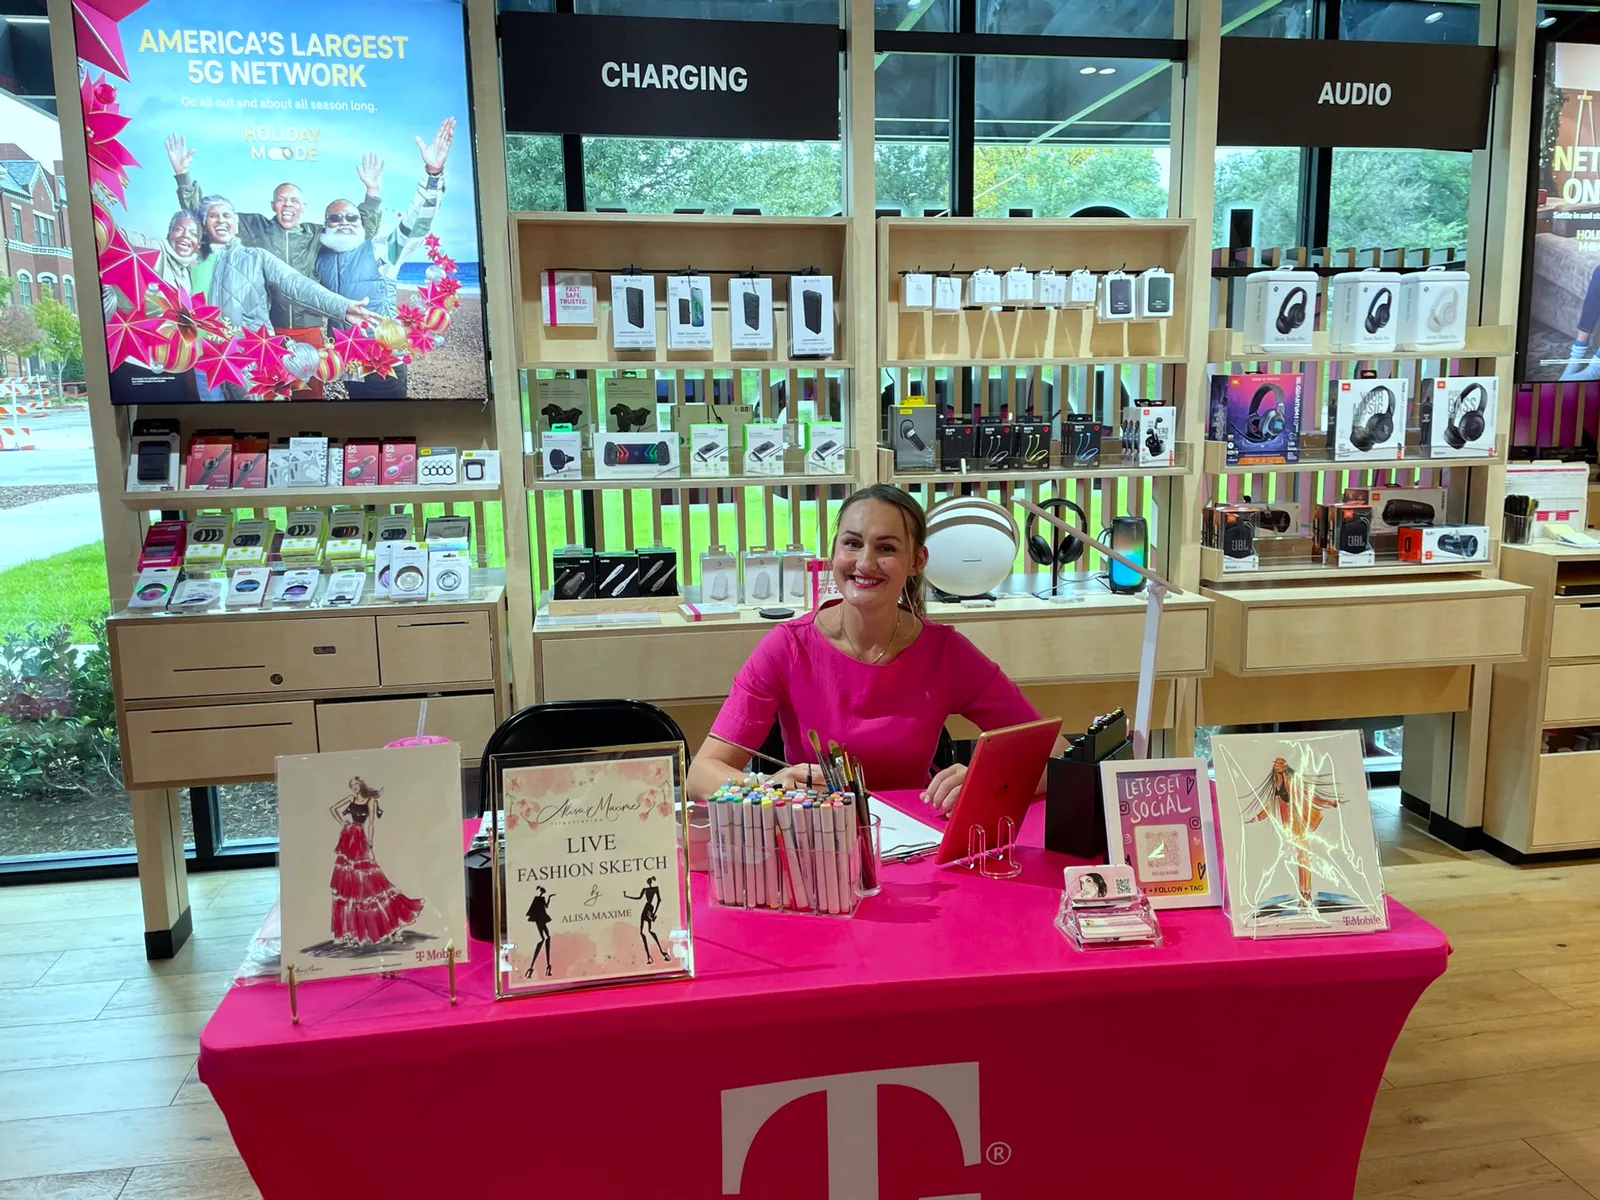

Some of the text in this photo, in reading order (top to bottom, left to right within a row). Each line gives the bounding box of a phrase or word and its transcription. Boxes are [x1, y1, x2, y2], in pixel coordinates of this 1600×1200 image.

[139, 29, 409, 59] AMERICA'S LARGEST
[188, 59, 367, 88] 5G NETWORK
[601, 61, 748, 92] CHARGING
[1317, 81, 1392, 106] AUDIO
[181, 96, 378, 113] Go all out and about all season long.
[243, 126, 321, 142] HOLIDAY
[1553, 212, 1573, 220] Settle
[1573, 212, 1580, 220] in
[1580, 212, 1593, 220] and
[1448, 397, 1477, 413] BASS
[1231, 539, 1249, 551] JBL
[1347, 535, 1365, 547] JBL
[1125, 773, 1182, 799] LET'S GET
[566, 833, 617, 854] LIVE
[517, 855, 667, 882] FASHION SKETCH
[561, 909, 632, 924] ALISA MAXIME
[1351, 915, 1381, 926] Mobile
[720, 1061, 981, 1200] T
